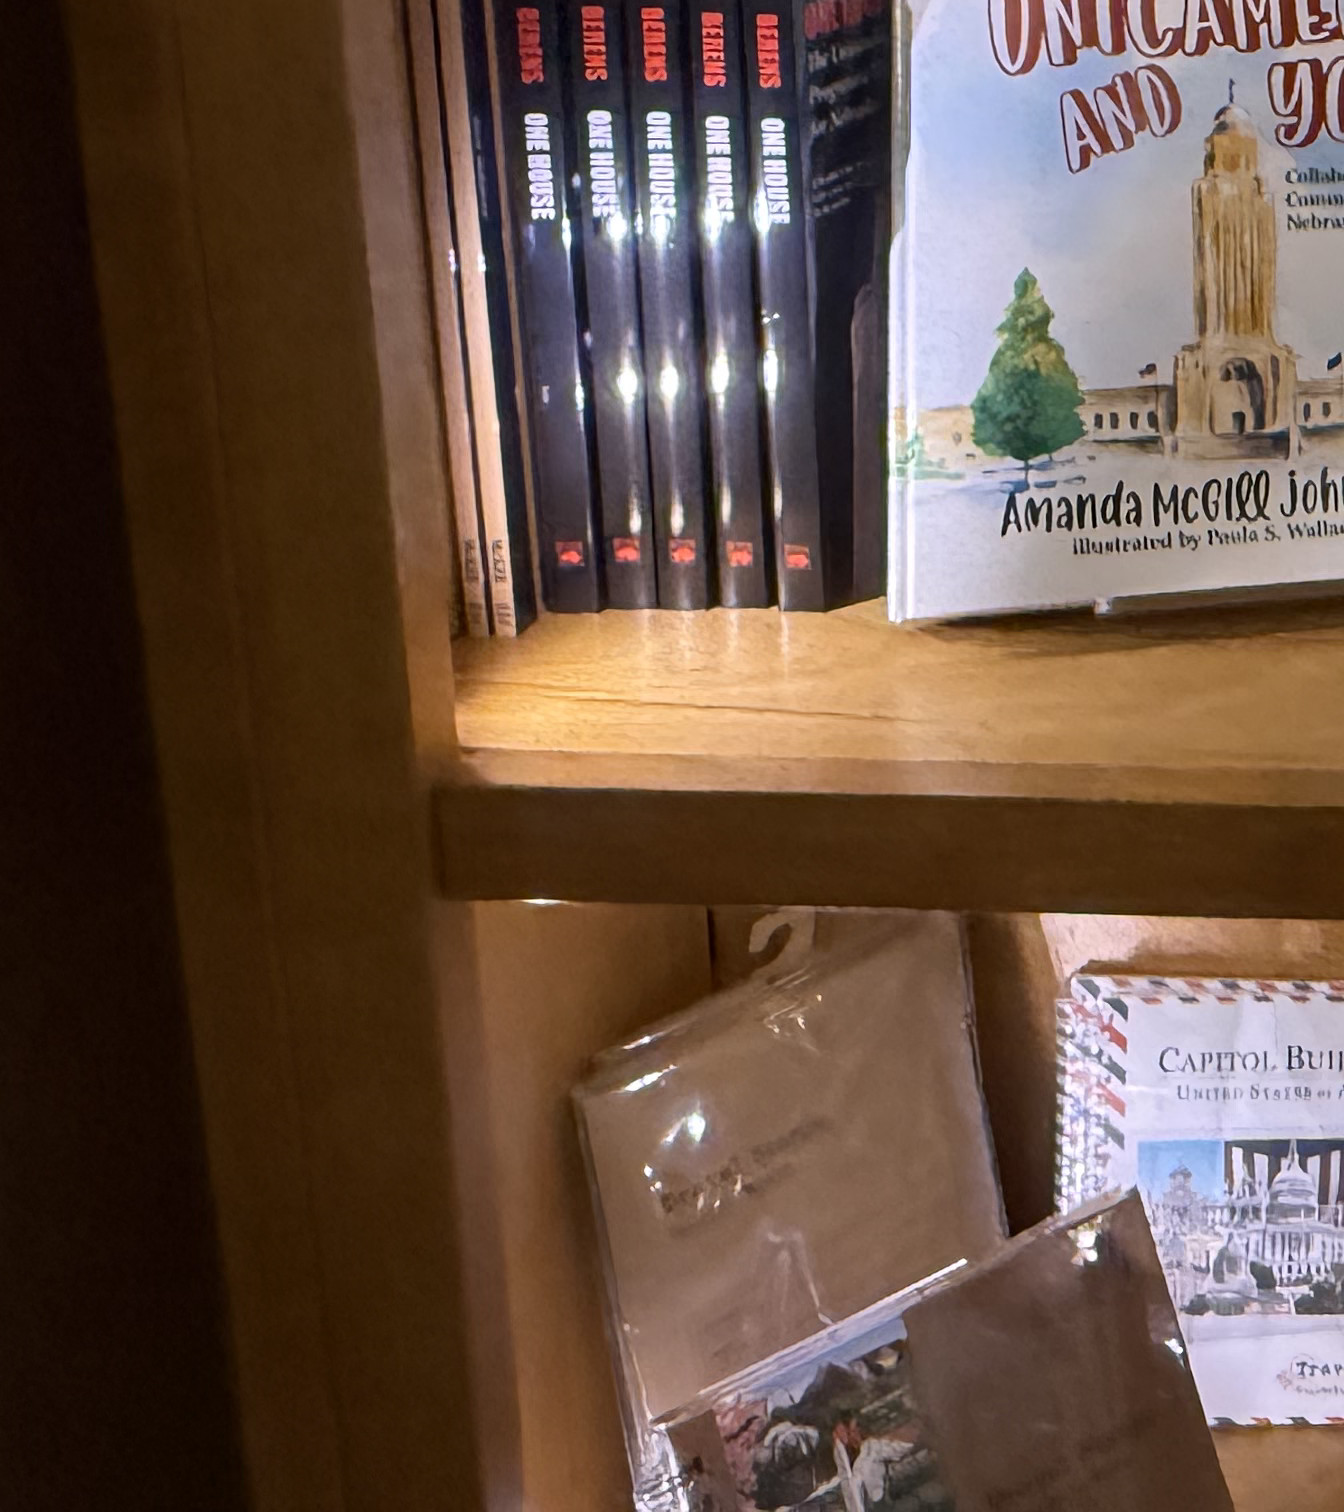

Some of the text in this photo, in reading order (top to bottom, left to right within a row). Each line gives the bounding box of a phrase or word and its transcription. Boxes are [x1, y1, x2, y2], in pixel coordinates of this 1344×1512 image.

[524, 112, 551, 152] ONE
[586, 108, 613, 150] ONE
[645, 110, 673, 151] ONE
[705, 115, 731, 156] ONE
[1058, 64, 1182, 173] AND
[760, 117, 791, 225] ONE HOUSE
[1000, 478, 1143, 539] Amanda
